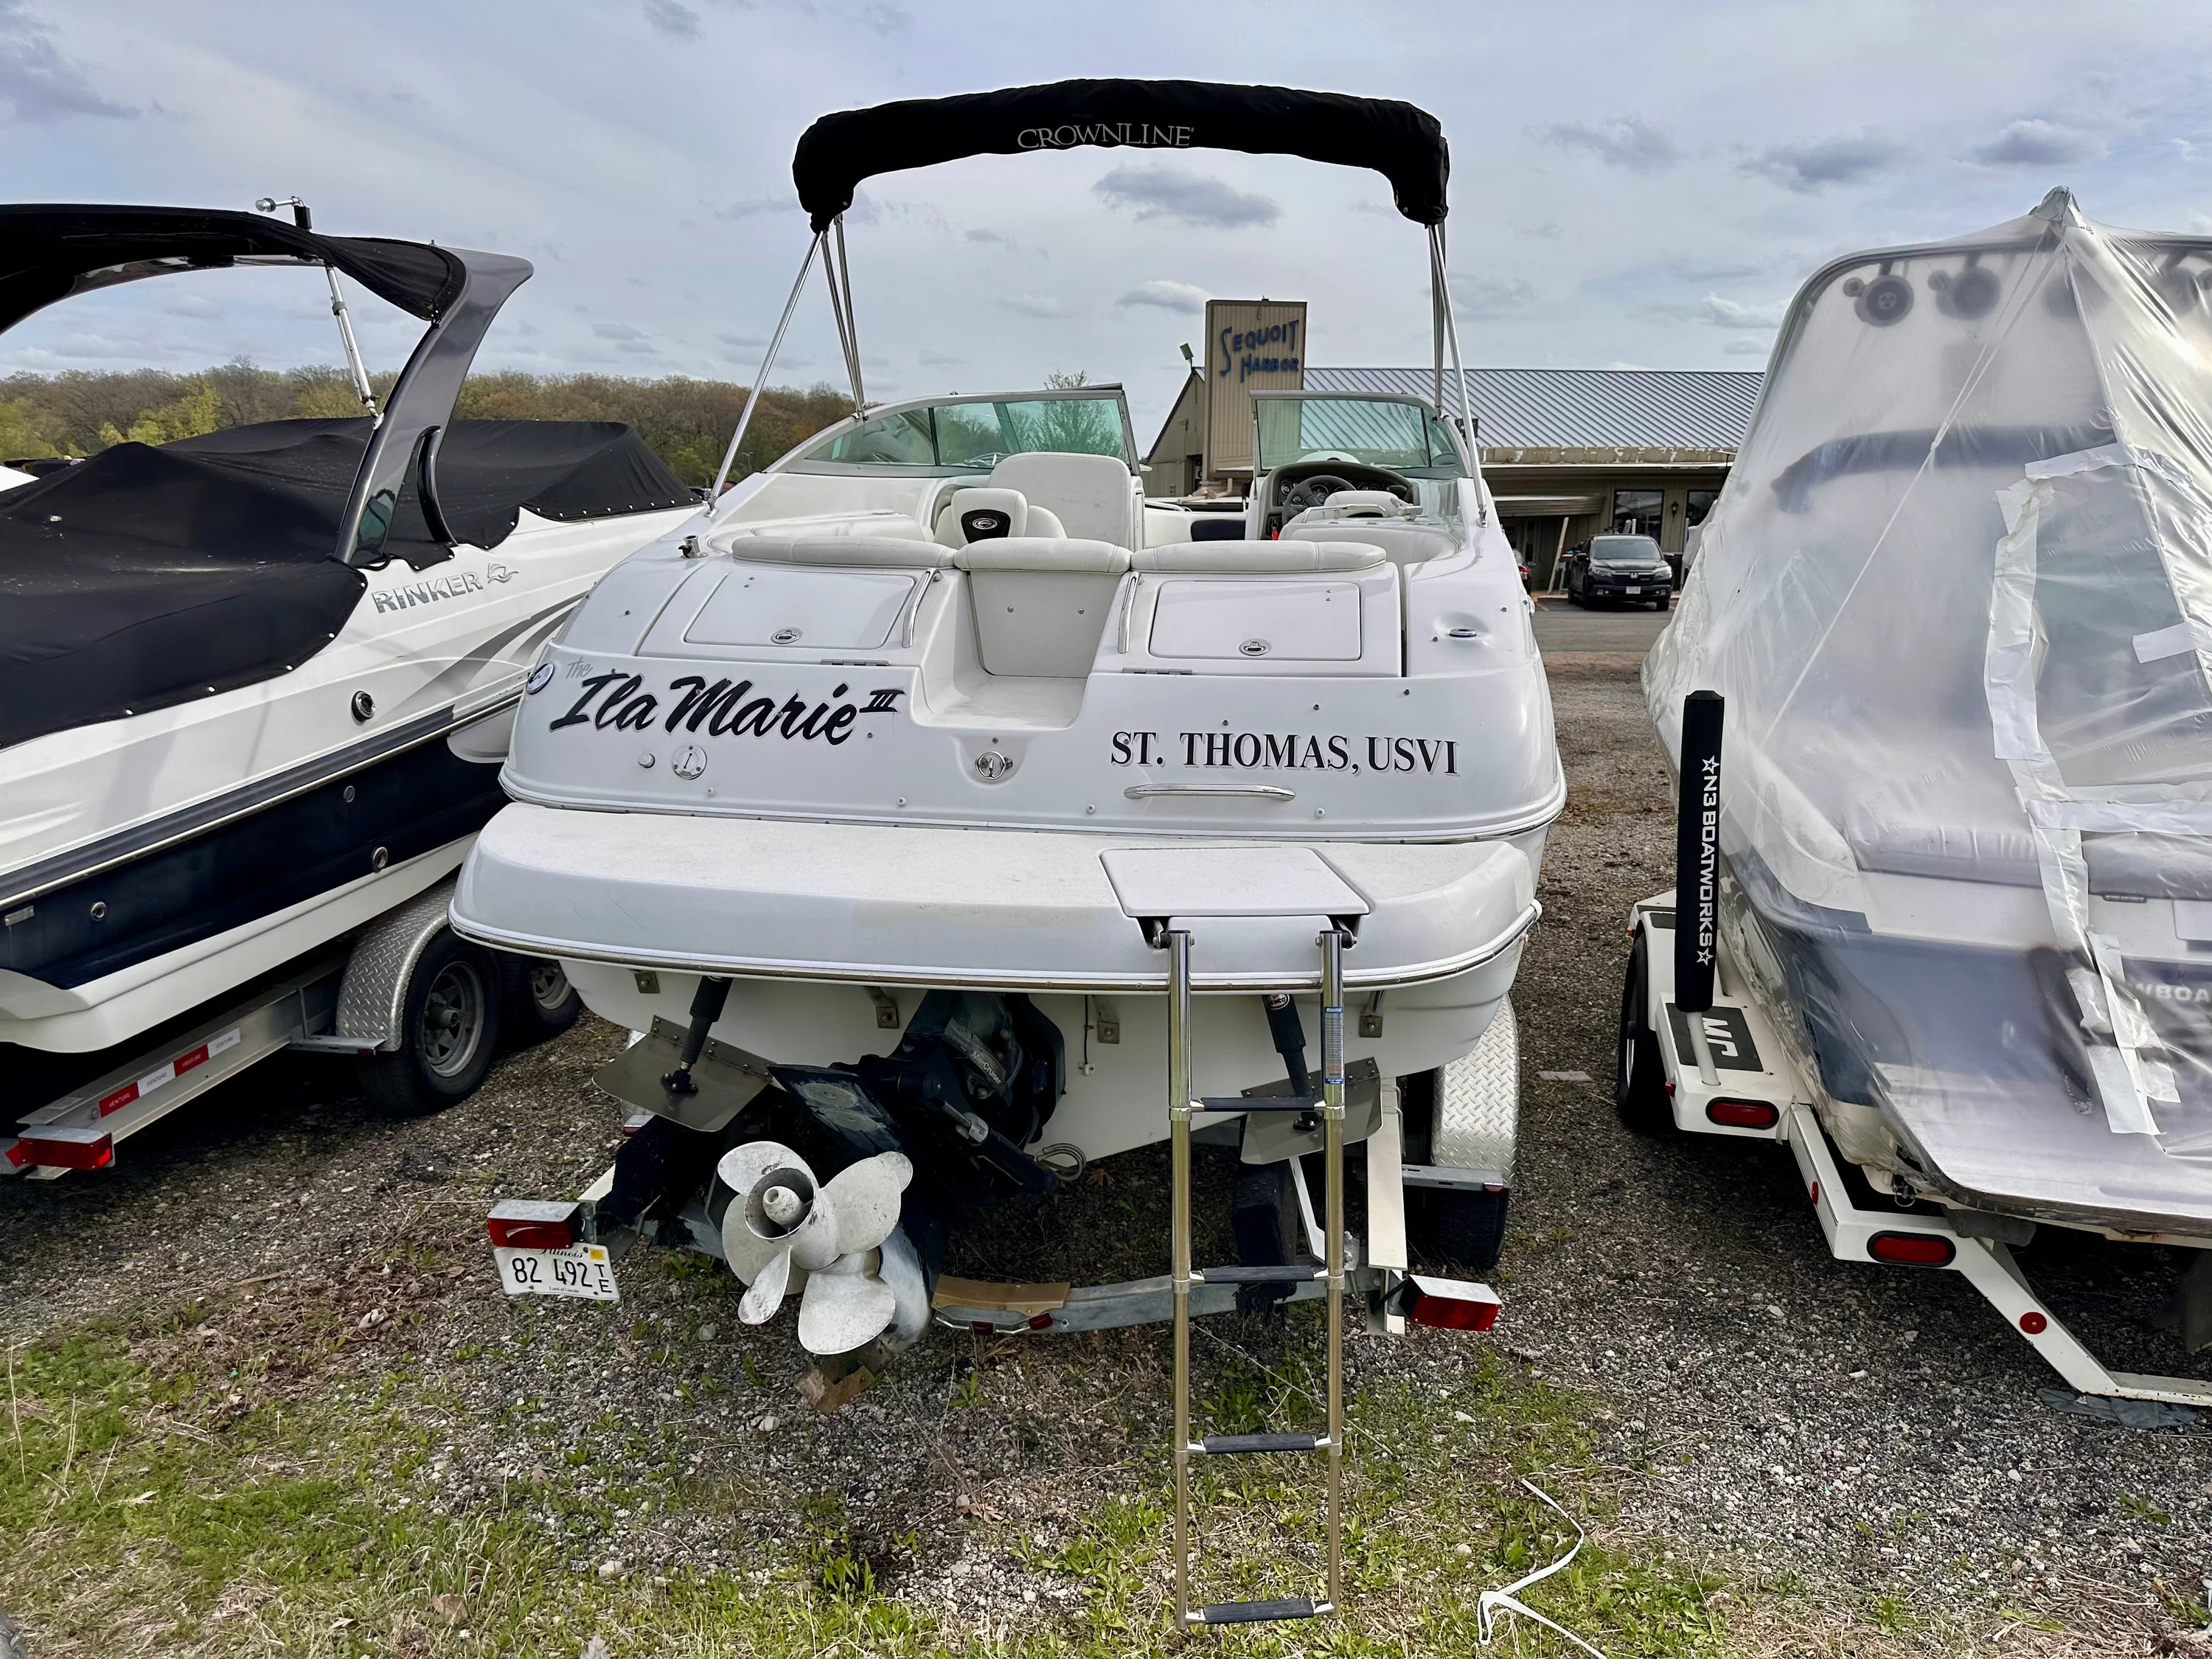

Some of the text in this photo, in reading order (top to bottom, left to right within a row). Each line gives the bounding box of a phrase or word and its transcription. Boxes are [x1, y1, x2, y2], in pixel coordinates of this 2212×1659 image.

[1018, 123, 1192, 148] CROWNLINE
[1220, 319, 1299, 377] SEQUOIT
[1240, 353, 1299, 383] HARBOR
[372, 571, 484, 613] RINKER
[566, 656, 593, 679] The
[549, 672, 658, 731] Ila
[664, 675, 858, 746] Marie
[1111, 731, 1165, 765] ST.
[1699, 775, 1718, 947] N3 BOATWORKS
[972, 1051, 1002, 1085] MerCruiser
[512, 1257, 543, 1284] 82
[553, 1259, 593, 1288] 492
